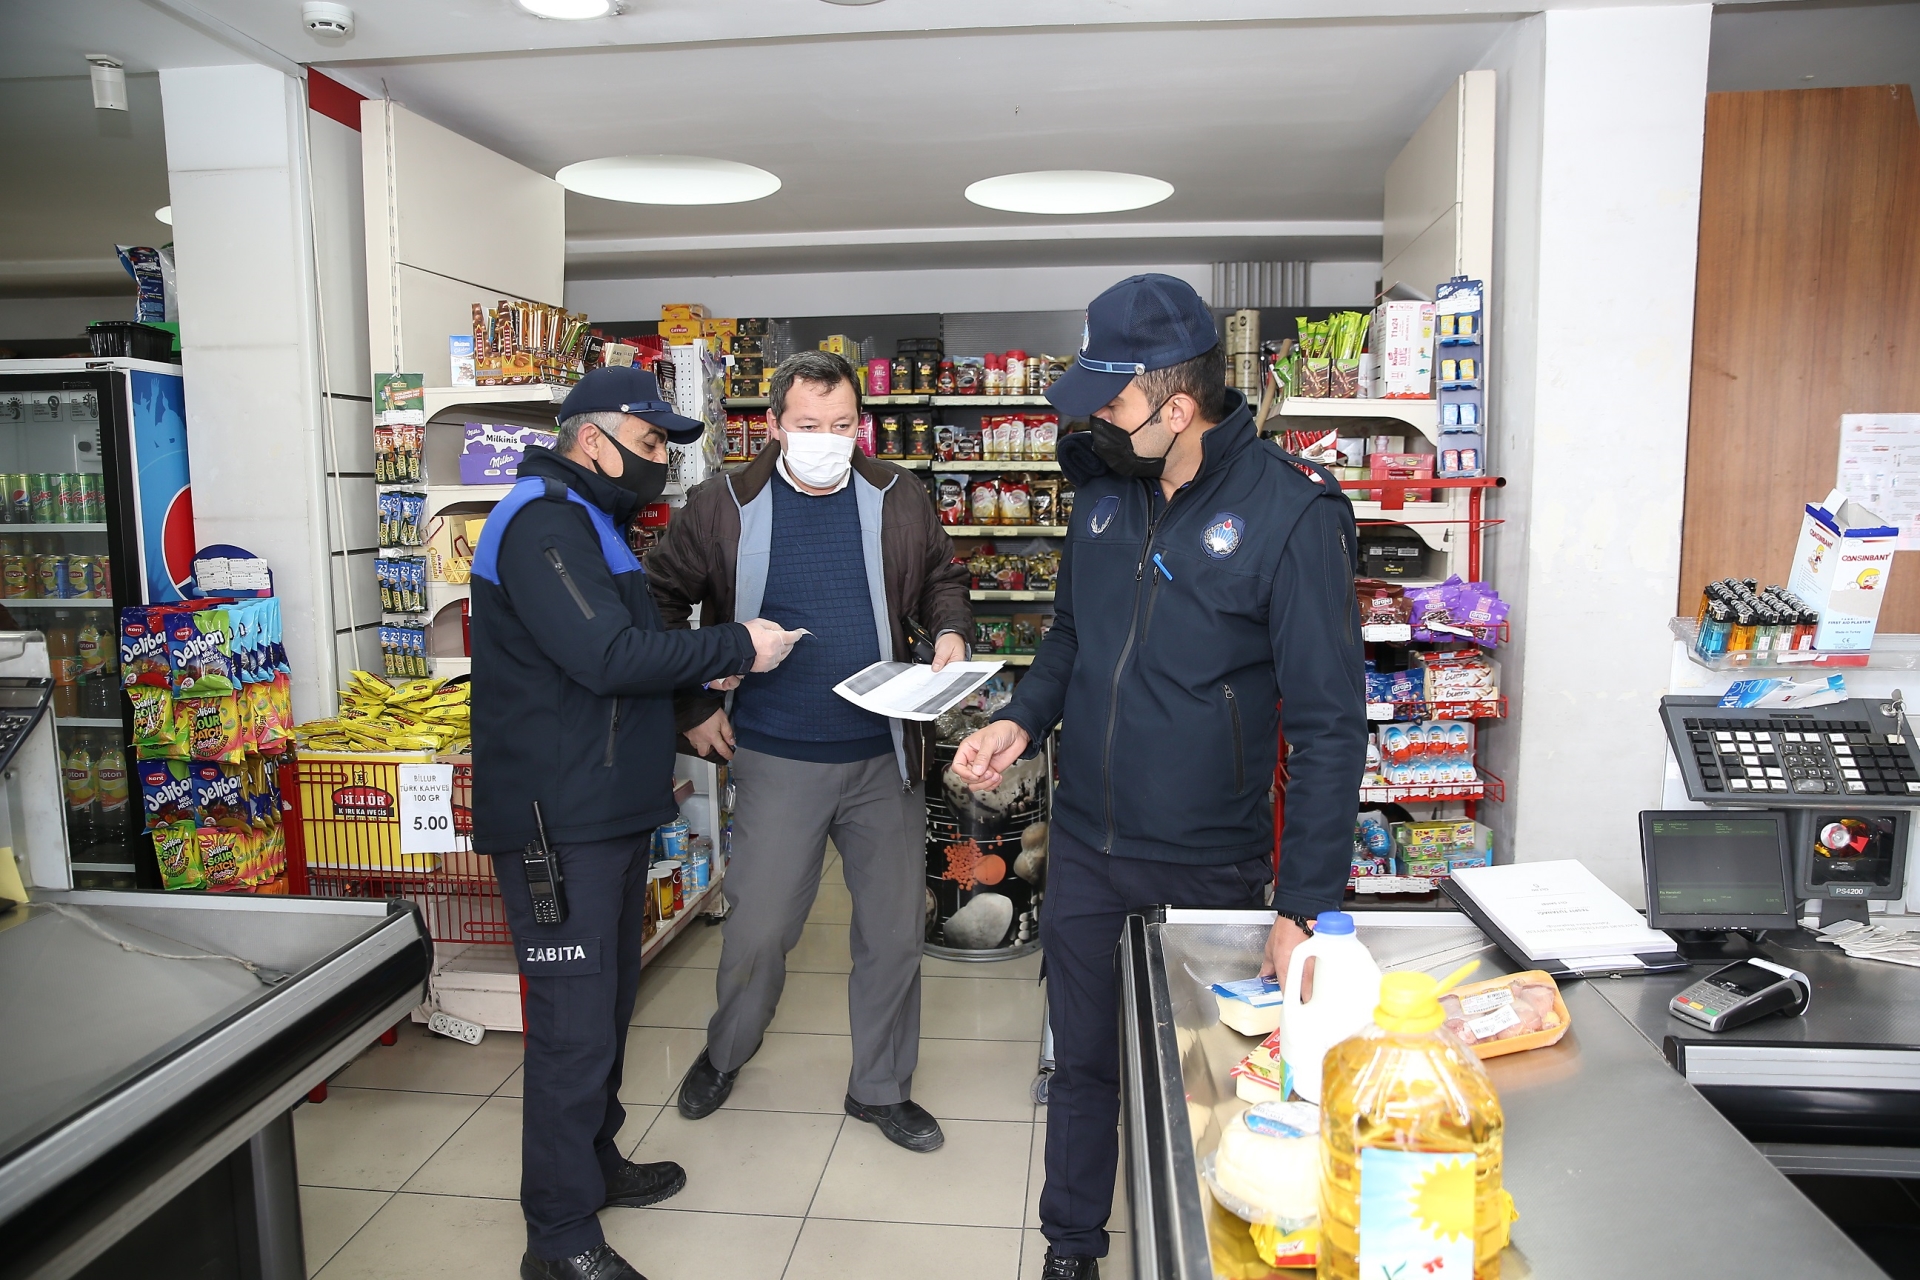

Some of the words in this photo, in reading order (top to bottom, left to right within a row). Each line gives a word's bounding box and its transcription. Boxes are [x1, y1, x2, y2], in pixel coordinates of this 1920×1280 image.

[485, 434, 518, 444] Milkinis
[173, 630, 224, 667] Jelibon
[400, 784, 417, 792] TÜRK
[413, 794, 427, 802] 100
[428, 794, 440, 802] GR
[413, 816, 448, 831] 5.00
[207, 851, 233, 866] SOUR
[208, 860, 236, 874] PATCH
[526, 944, 586, 962] ZABITA
